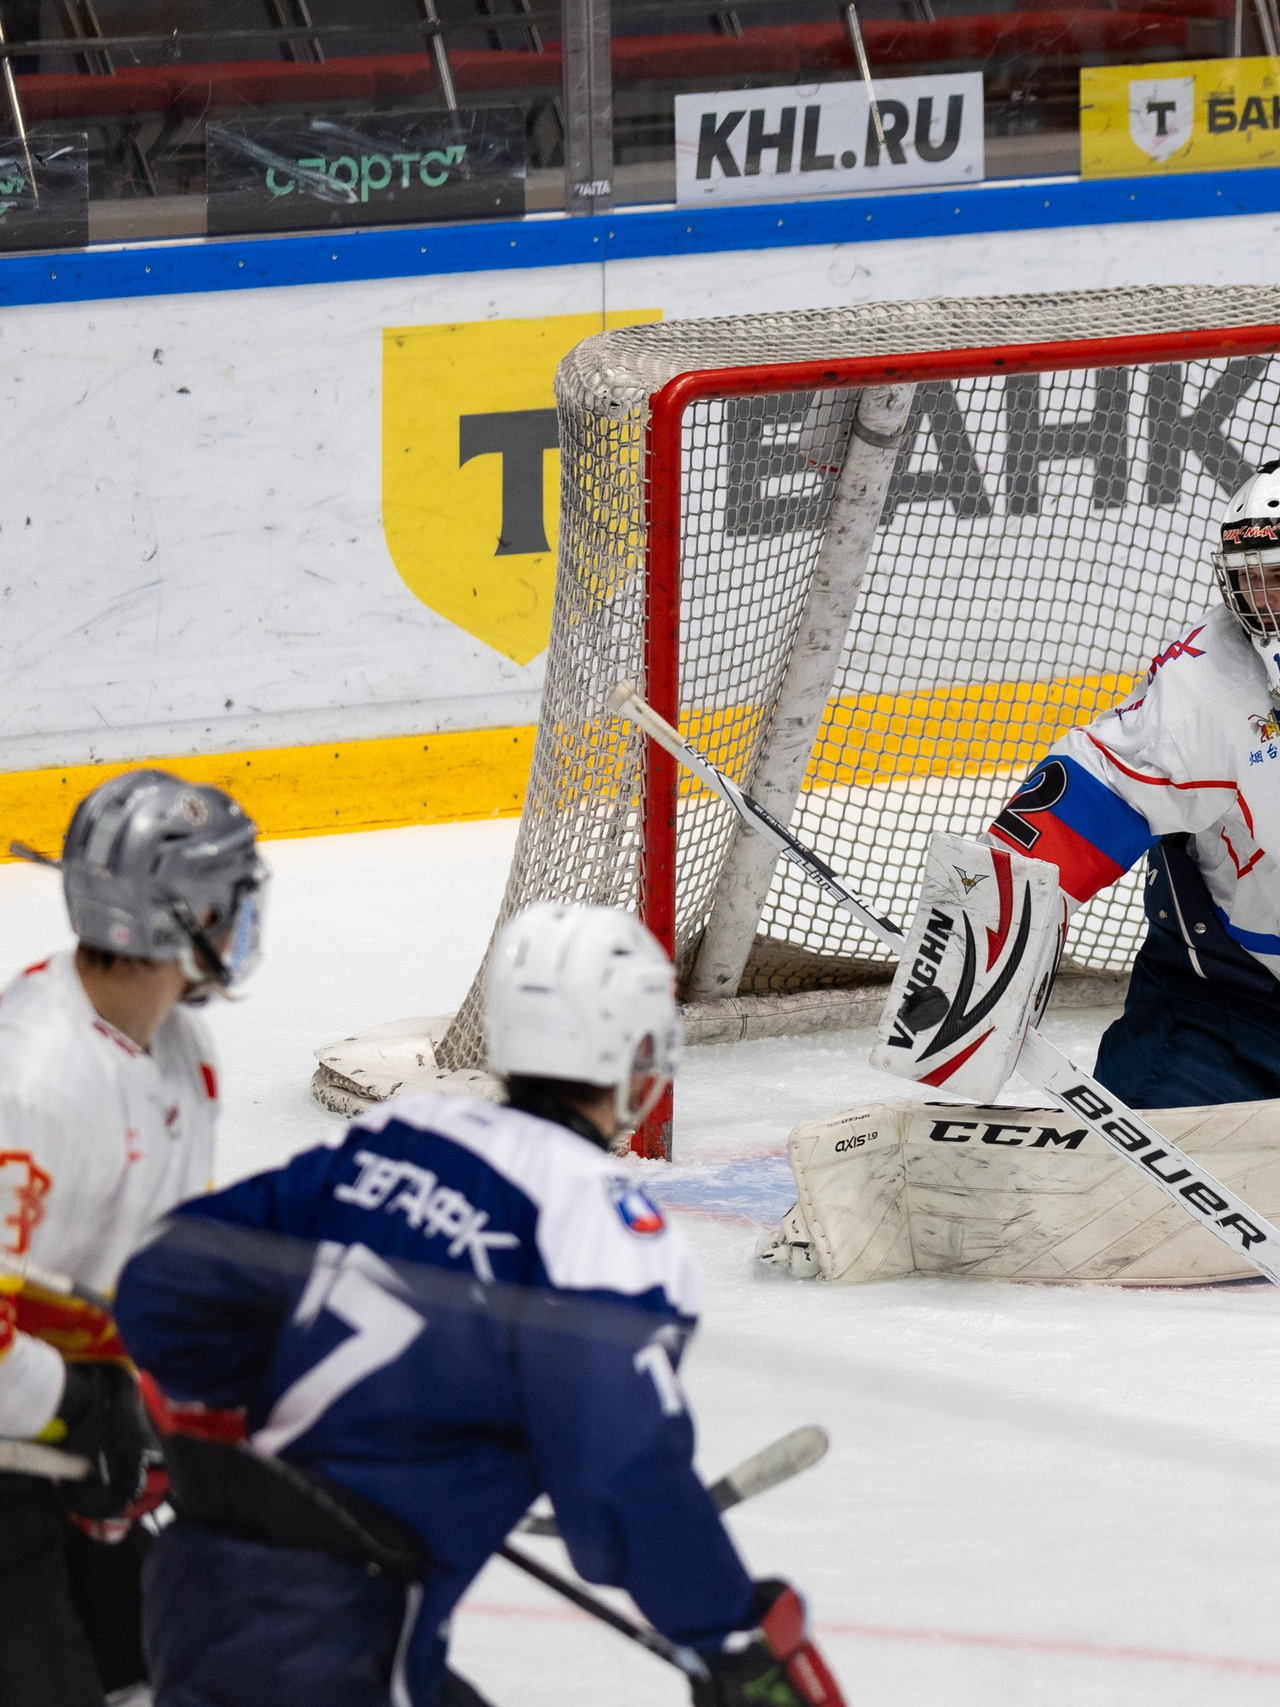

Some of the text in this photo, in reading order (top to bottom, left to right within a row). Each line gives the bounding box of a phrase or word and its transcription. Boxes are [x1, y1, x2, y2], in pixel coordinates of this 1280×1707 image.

[696, 94, 964, 181] KHL.RU
[726, 357, 1268, 538] БАНК
[887, 907, 955, 1050] VUGHN
[928, 1119, 1089, 1150] CCM
